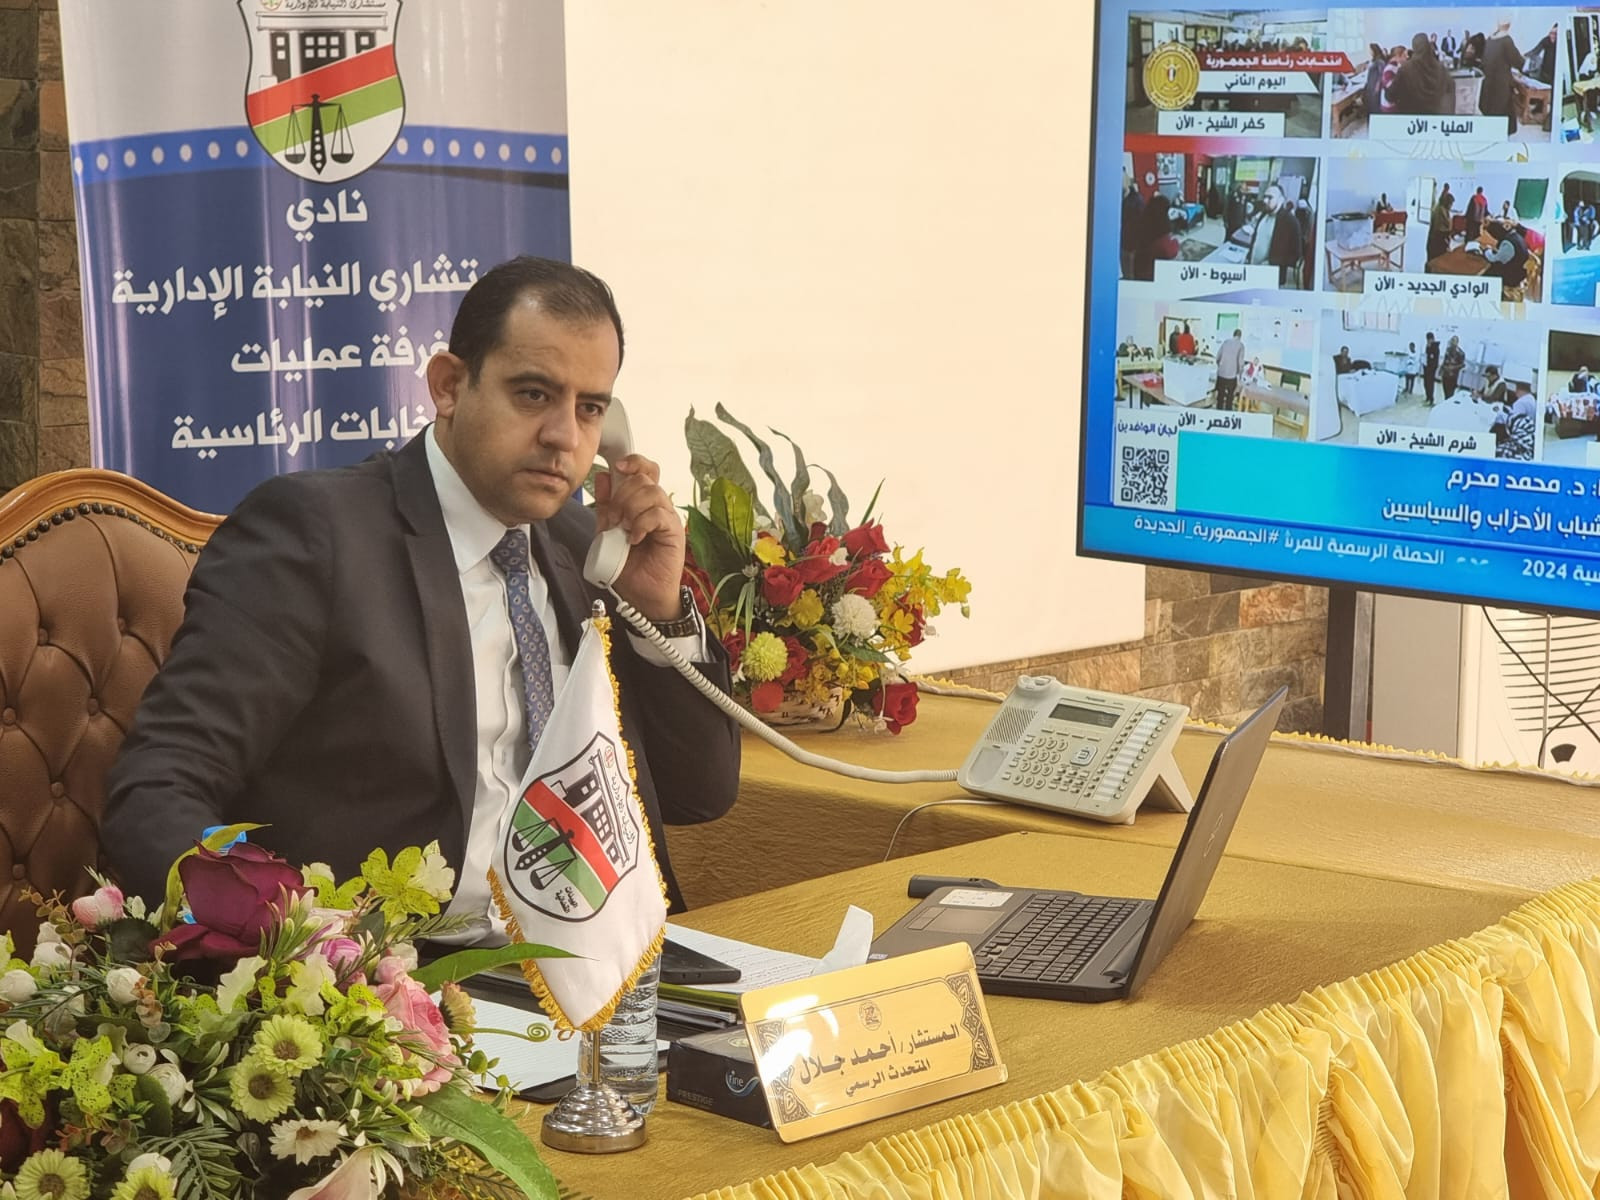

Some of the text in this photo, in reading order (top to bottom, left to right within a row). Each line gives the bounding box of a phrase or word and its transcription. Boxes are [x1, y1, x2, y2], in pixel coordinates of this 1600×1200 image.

[1206, 54, 1342, 69] انتخابات رئاسة الجمهورية
[1225, 73, 1286, 92] اليوم الثاني
[1205, 115, 1238, 133] الشيخ
[1240, 116, 1265, 133] كفر
[1441, 119, 1473, 136] المنيا
[286, 189, 368, 242] نادي
[112, 253, 480, 320] تشاري النيابة الإدارية
[1408, 279, 1446, 295] الجديد
[1450, 281, 1489, 298] الوادي
[231, 336, 362, 382] عمليات
[172, 404, 430, 460] خابات الرئاسية
[1117, 420, 1178, 437] لجان الوافدين
[1206, 414, 1242, 431] الأقصر
[1409, 432, 1445, 449] الشيخ
[1448, 435, 1477, 453] شرم
[1447, 469, 1500, 491] محرم
[1505, 474, 1561, 494] محمد
[1382, 498, 1482, 530] والسياسيين
[1487, 505, 1551, 534] الأحزاب
[1327, 538, 1388, 562] الرسمية
[1392, 545, 1444, 565] الحملة
[1522, 559, 1568, 580] 2024
[850, 1030, 897, 1066] أحمد
[908, 1023, 960, 1054] المستشار
[799, 1052, 846, 1085] جلال
[845, 1057, 931, 1097] المتحدث الرسمي
